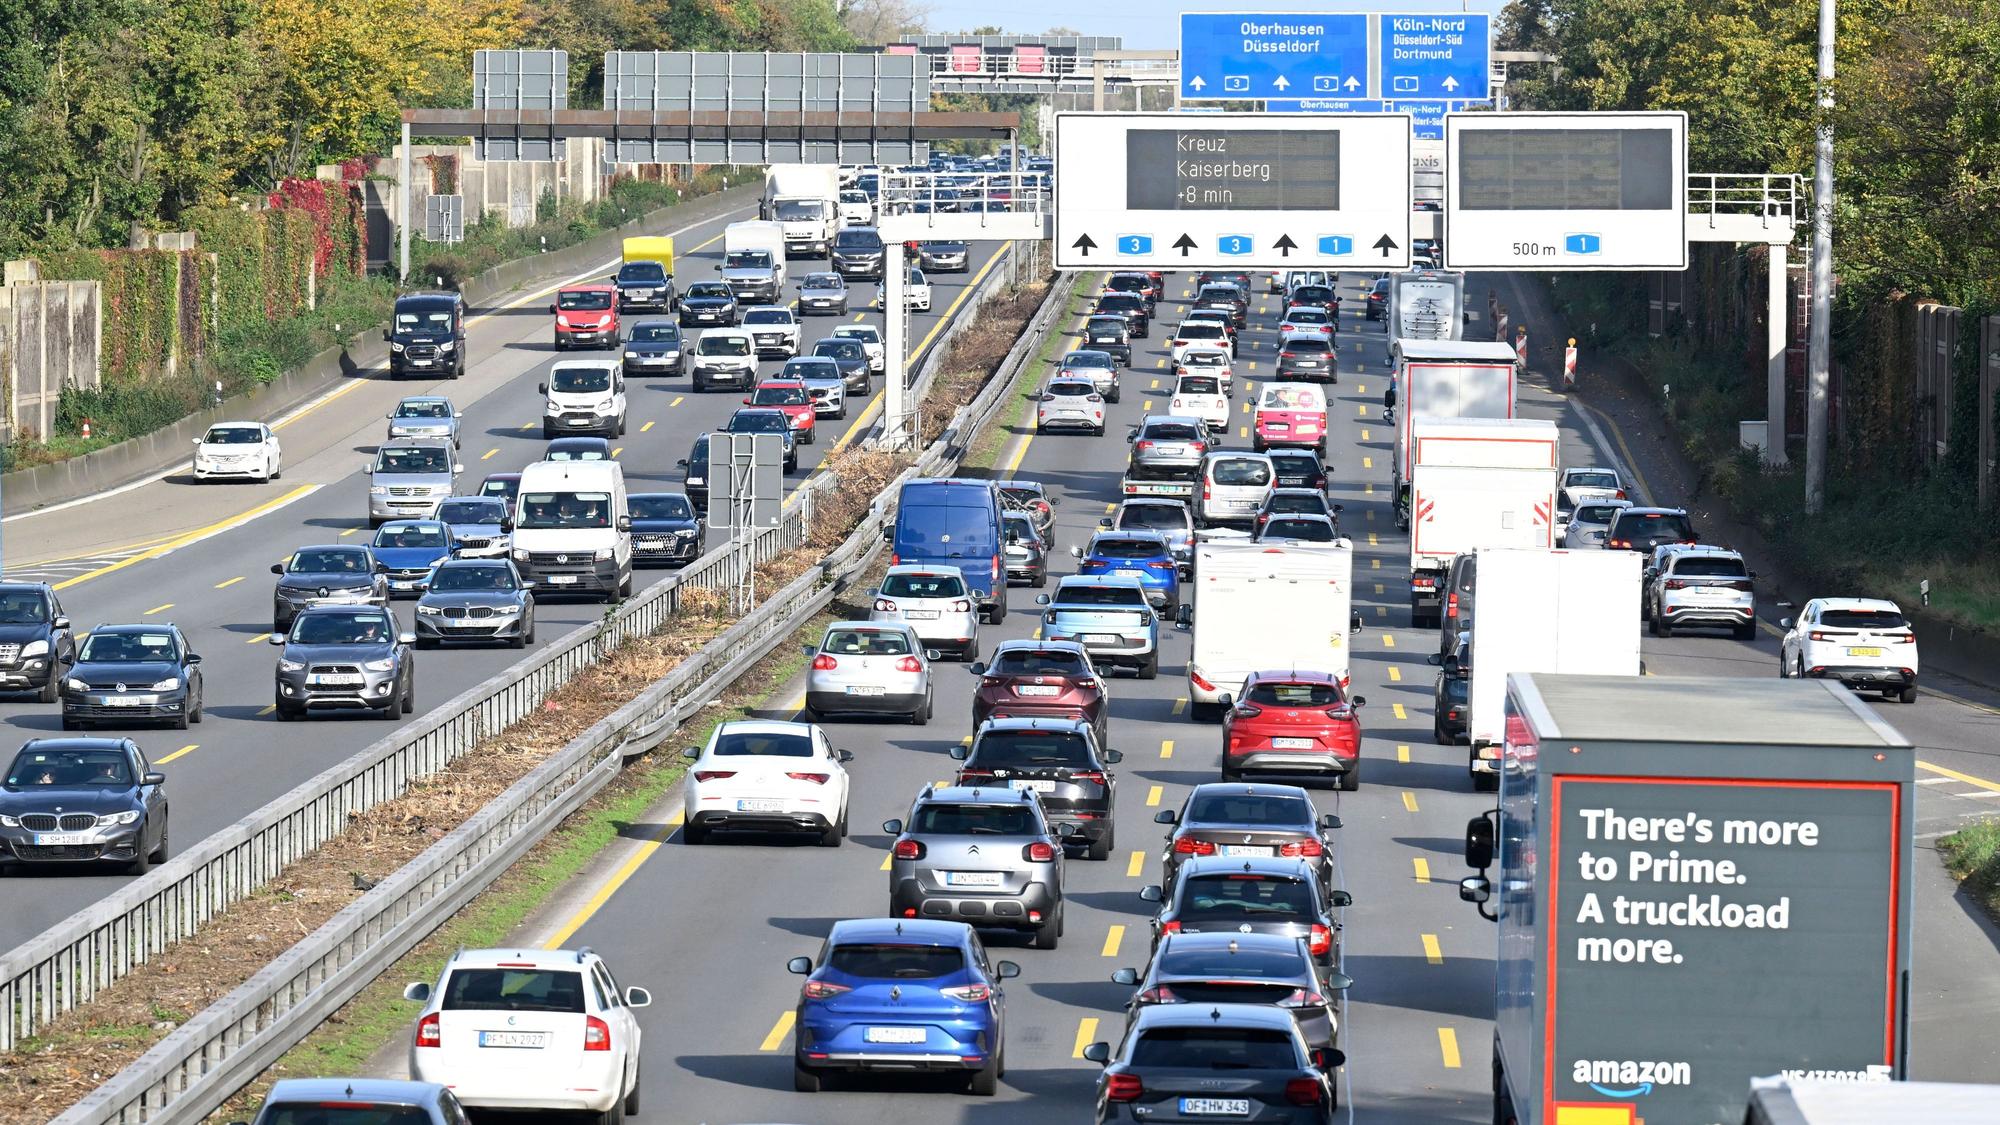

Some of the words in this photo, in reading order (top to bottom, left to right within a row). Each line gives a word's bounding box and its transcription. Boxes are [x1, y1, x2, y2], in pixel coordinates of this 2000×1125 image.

[1241, 23, 1324, 35] Oberhausen
[1394, 19, 1465, 31] Köln-Nord
[1394, 34, 1462, 45] Düsseldorf-Süd
[1244, 40, 1319, 53] Düsseldorf
[1394, 48, 1452, 59] Dortmund
[1233, 79, 1240, 88] 3
[1323, 79, 1330, 88] 3
[1300, 101, 1349, 109] Oberhausen
[1177, 135, 1226, 152] Kreuz
[1177, 161, 1270, 182] Kaiserberg
[1177, 186, 1197, 204] +8
[1204, 187, 1232, 203] min
[1131, 239, 1140, 252] 3
[1231, 239, 1240, 252] 3
[1513, 243, 1539, 256] 500
[1542, 246, 1556, 256] m
[1579, 808, 1713, 843] There's
[1723, 819, 1820, 846] more
[1578, 851, 1618, 881] to
[1629, 850, 1747, 885] Prime.
[1576, 893, 1605, 924] A
[1613, 894, 1790, 930] truckload
[1577, 937, 1684, 964] more.
[1573, 1060, 1691, 1085] amazon
[1187, 1100, 1200, 1111] OF
[1209, 1101, 1224, 1111] HW
[1226, 1101, 1247, 1112] 343
